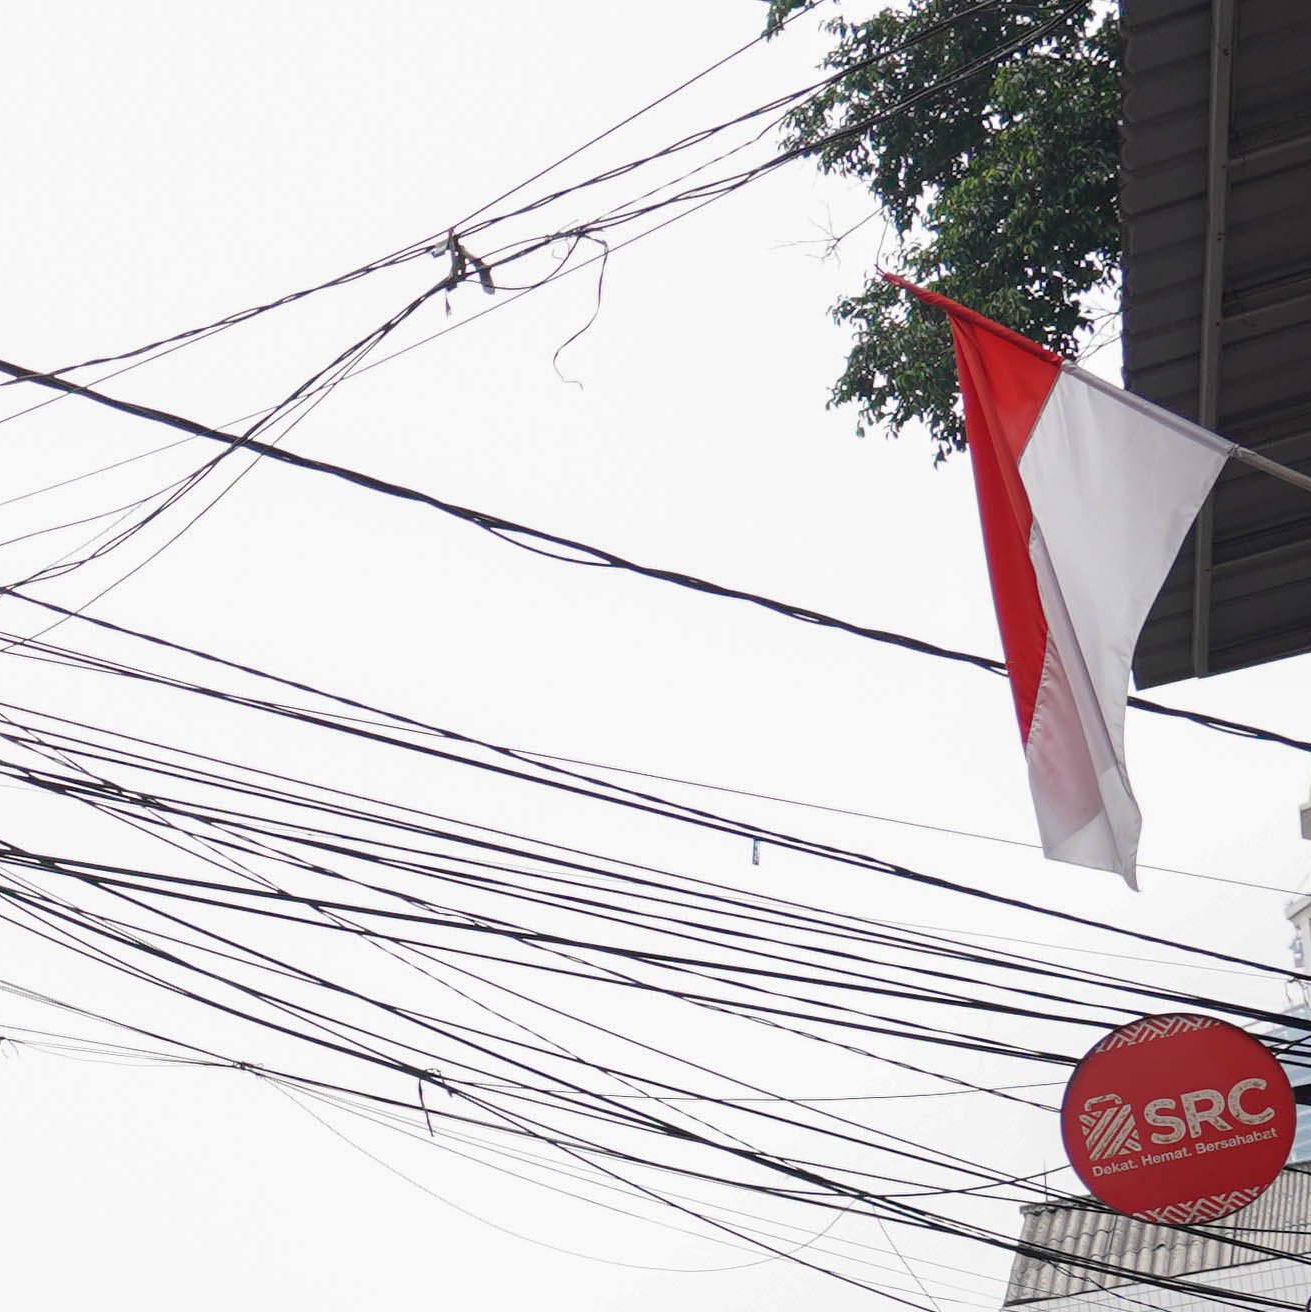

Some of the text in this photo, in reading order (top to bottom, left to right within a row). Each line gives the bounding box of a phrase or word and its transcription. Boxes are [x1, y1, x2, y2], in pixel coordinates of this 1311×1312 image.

[1144, 1078, 1275, 1145] SRC
[1092, 1127, 1278, 1177] Dekat. Hemat. Bersahabat
